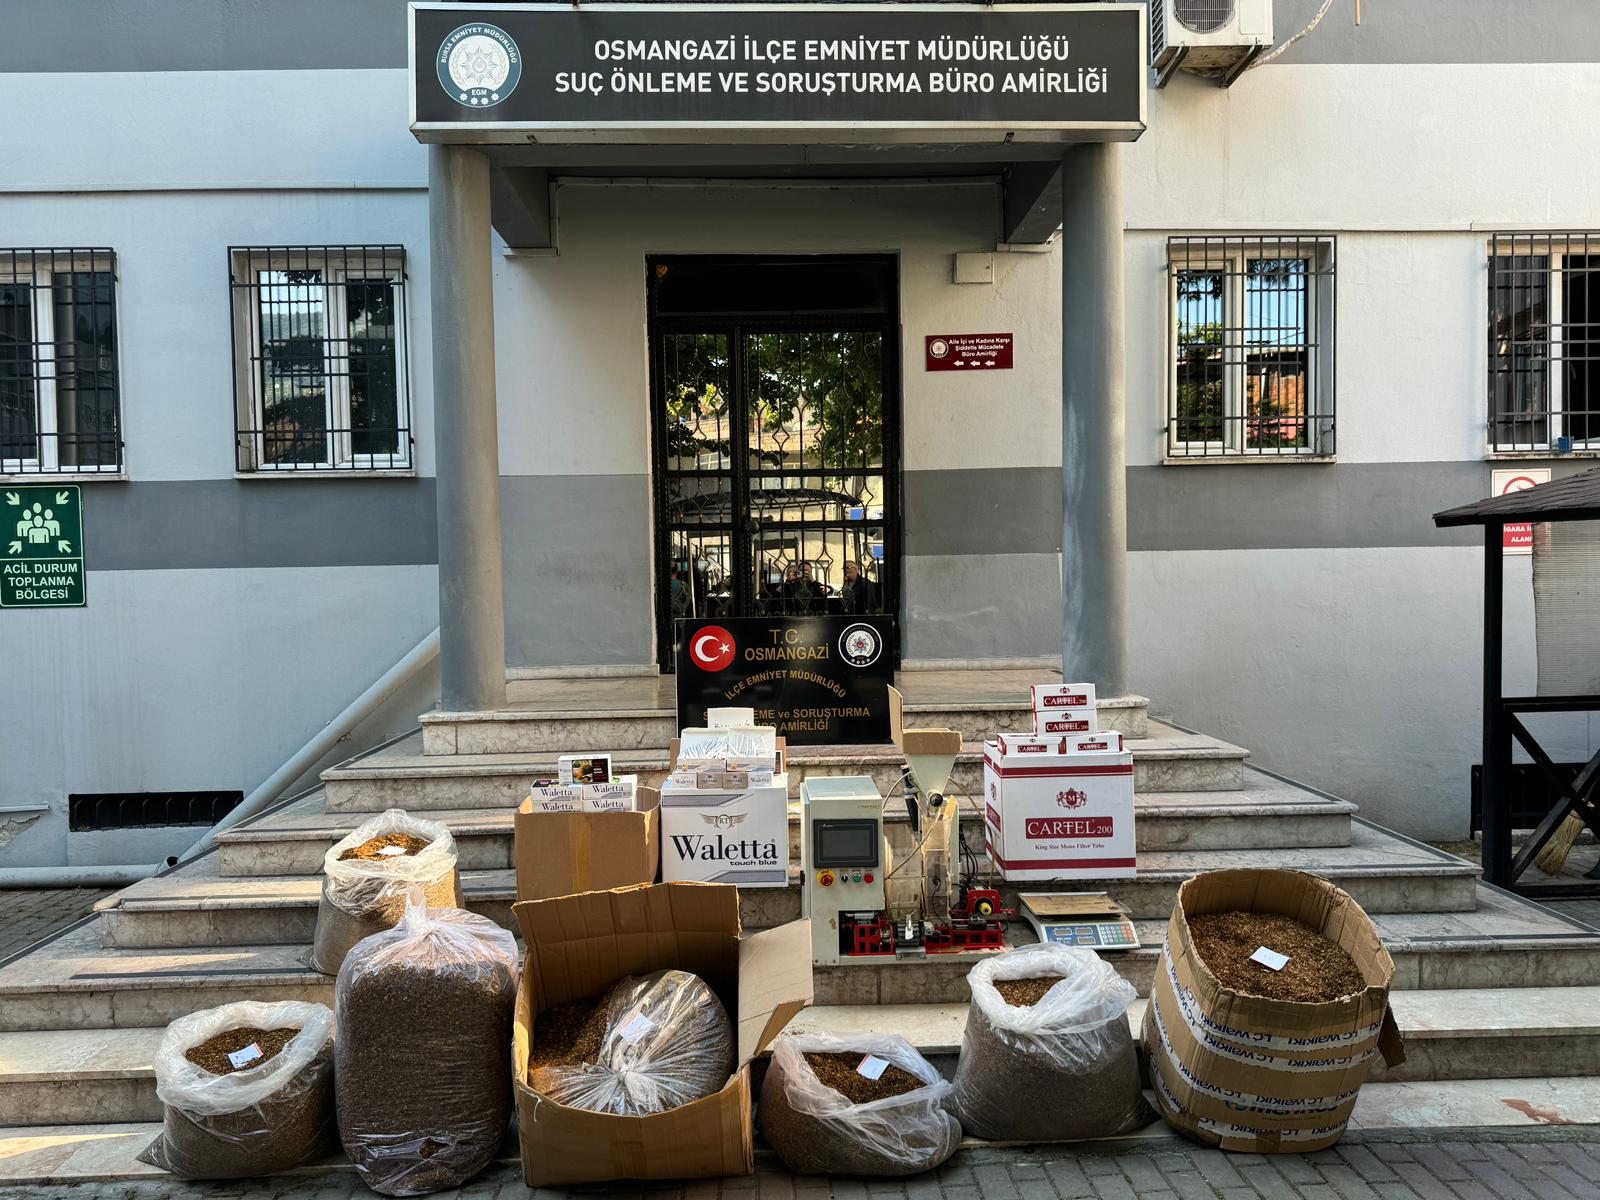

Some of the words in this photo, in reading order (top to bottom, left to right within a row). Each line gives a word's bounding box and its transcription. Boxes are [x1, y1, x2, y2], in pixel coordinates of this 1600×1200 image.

[440, 42, 453, 63] BURSA
[450, 26, 483, 43] EMNİYET
[594, 35, 736, 61] OSMANGAZİ
[744, 35, 797, 64] İLÇE
[804, 35, 910, 61] EMNİYET
[917, 35, 1069, 61] MÜDÜRLÜĞÜ
[555, 72, 604, 96] SUÇ
[611, 67, 712, 93] ÖNLEME
[722, 72, 749, 93] VE
[755, 72, 922, 96] SORUŞTURMA
[929, 68, 995, 93] BÜRO
[1001, 68, 1108, 94] AMİRLİĞİ
[4, 562, 31, 574] ACİL
[34, 563, 78, 574] DURUM
[8, 576, 75, 587] TOPLANMA
[15, 587, 69, 600] BÖLGESİ
[769, 629, 803, 644] T.C.
[744, 643, 829, 661] OSMANGAZİ
[724, 681, 746, 700] İLÇE
[746, 670, 787, 686] EMNİYET
[789, 669, 847, 698] MÜDÜRLÜĞÜ
[1044, 696, 1079, 706] CARTEL
[793, 707, 871, 719] SORUŞTURMA
[780, 719, 829, 731] AMİRLİĞİ
[1046, 722, 1081, 732] CARTEL
[540, 788, 573, 796] Waletta
[592, 785, 624, 793] Waletta
[541, 802, 574, 810] Waletta
[592, 800, 624, 808] Waletta
[1027, 820, 1096, 836] CARTEL
[1096, 826, 1112, 834] 200
[669, 834, 779, 861] Waletta
[1252, 1032, 1272, 1042] LC
[1257, 1052, 1274, 1063] LC
[1224, 1088, 1242, 1099] LC
